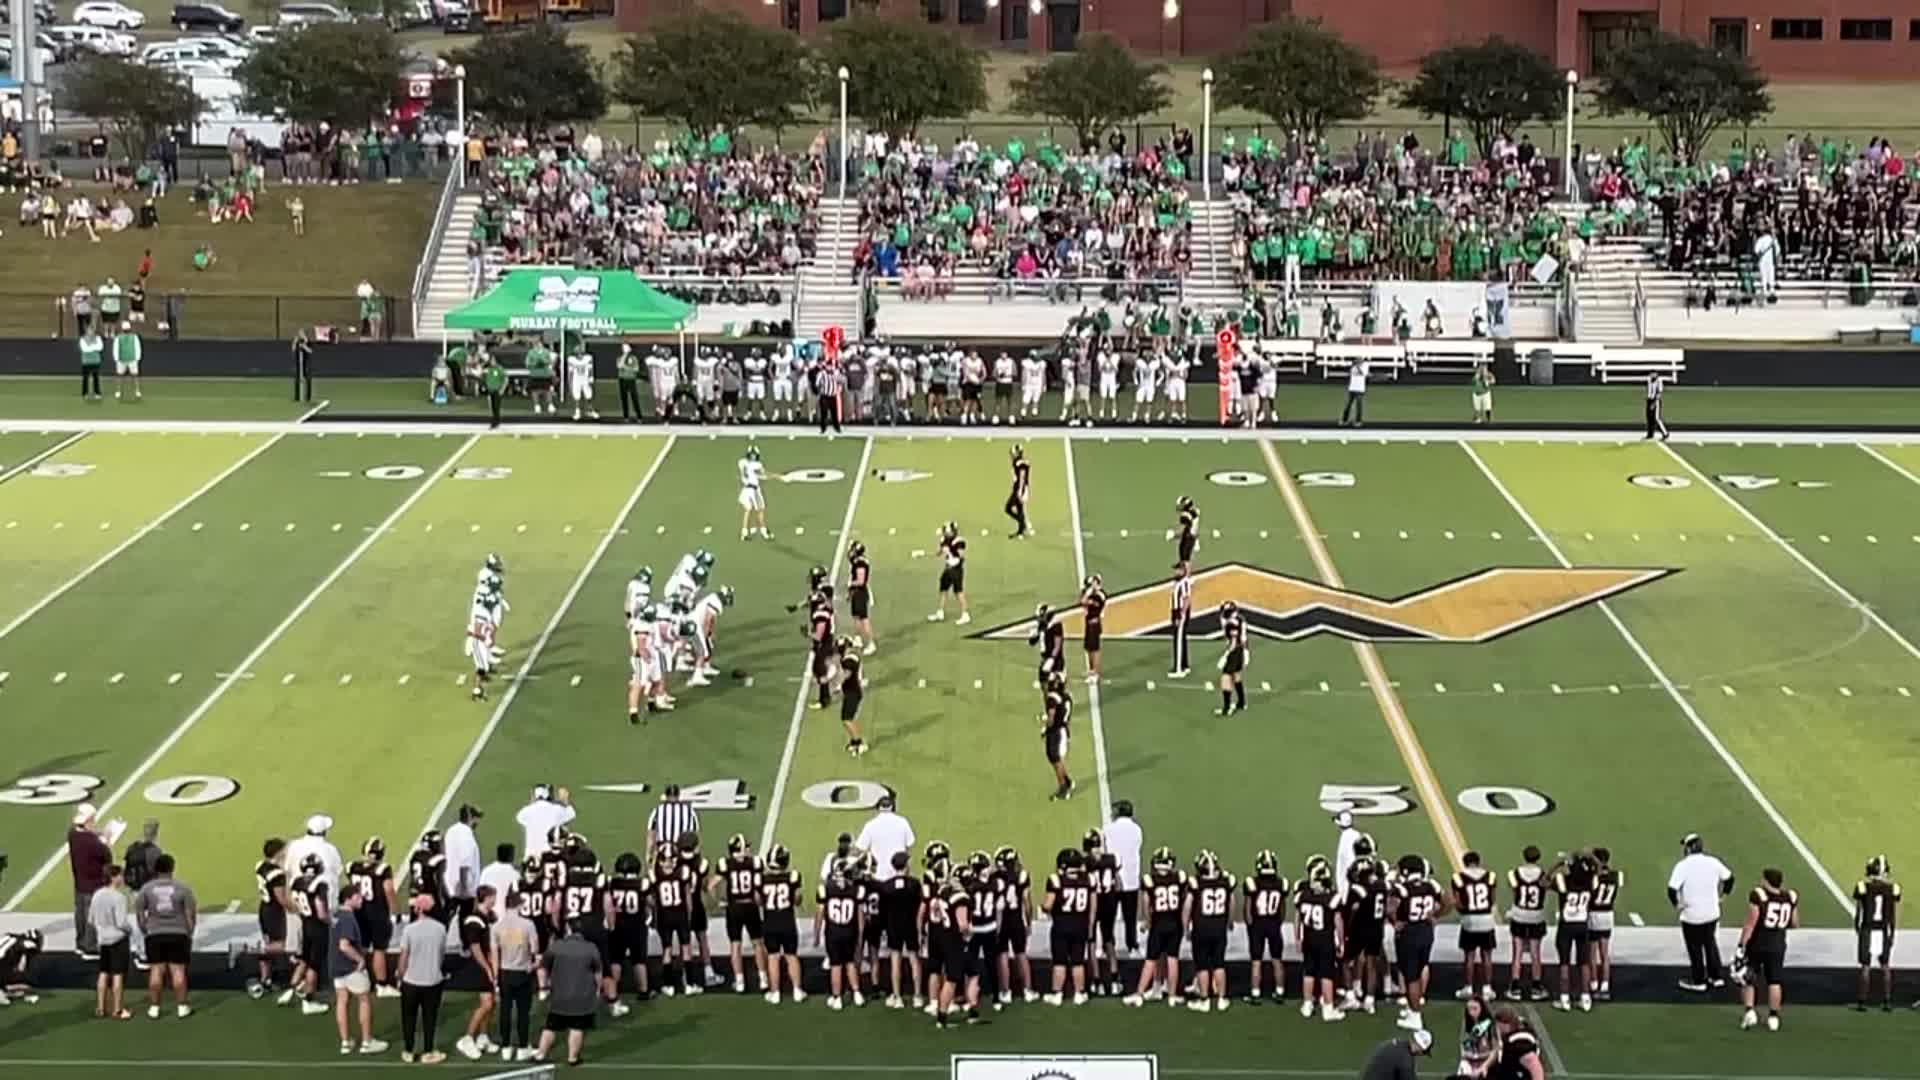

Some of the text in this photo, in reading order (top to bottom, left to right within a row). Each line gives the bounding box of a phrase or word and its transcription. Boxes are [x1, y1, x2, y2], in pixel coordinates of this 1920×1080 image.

[510, 316, 617, 329] MURRAY FOOTBALL
[1319, 784, 1548, 816] 50
[566, 886, 594, 914] 67
[613, 889, 639, 915] 70
[659, 880, 682, 907] 81
[762, 882, 790, 910] 72
[1154, 885, 1179, 911] 26
[1202, 887, 1227, 916] 62
[1256, 889, 1281, 916] 40
[1466, 883, 1490, 911] 12
[1519, 885, 1540, 909] 13
[827, 897, 854, 925] 60
[1301, 903, 1325, 931] 79
[1764, 901, 1792, 929] 50
[1874, 894, 1884, 922] 1
